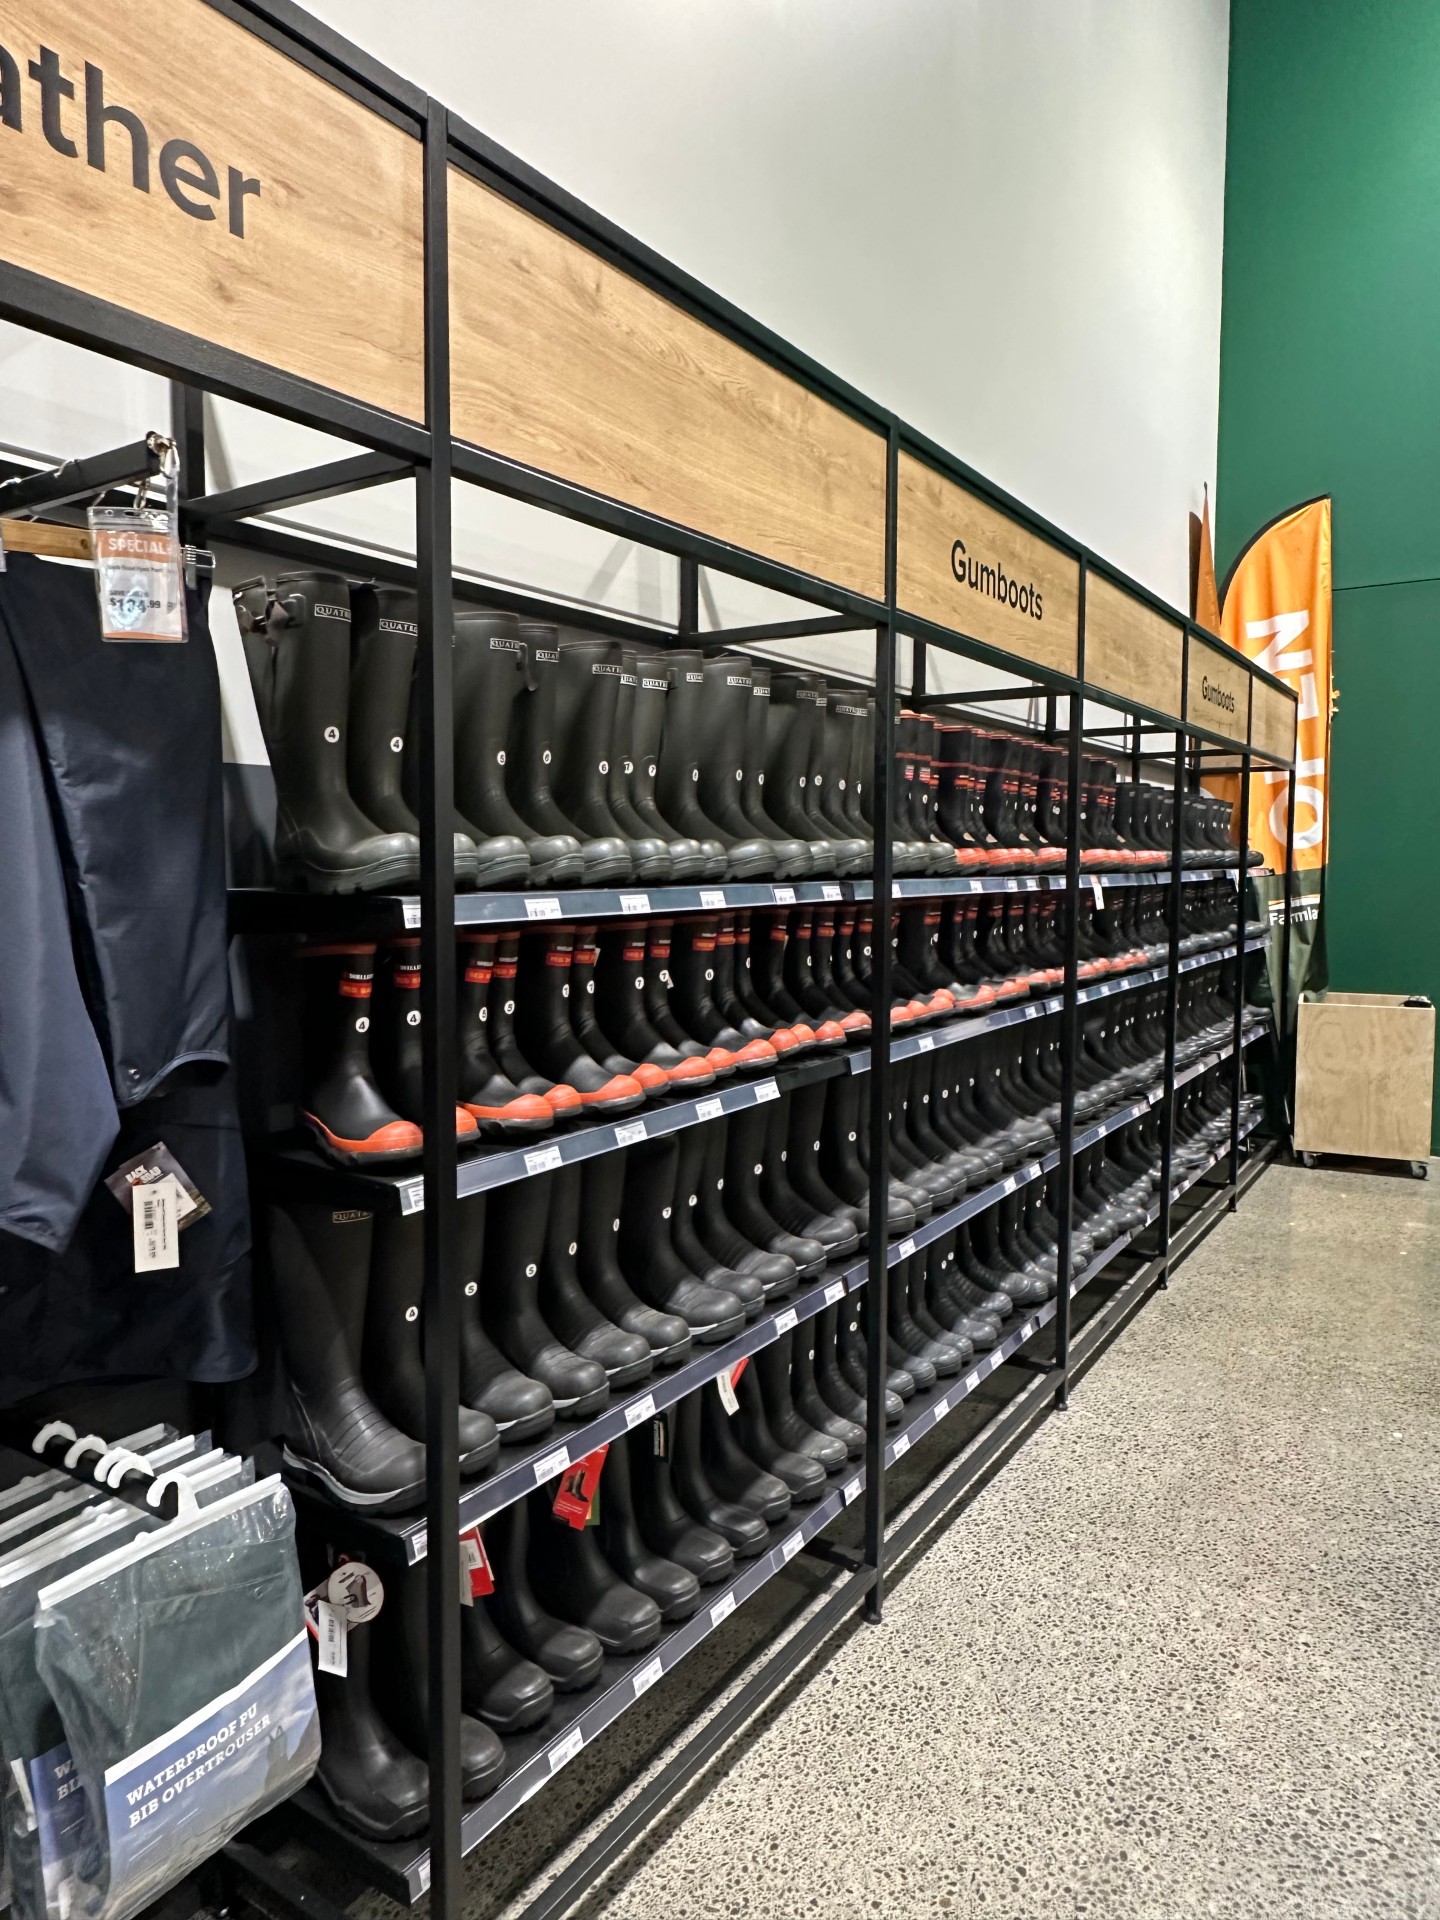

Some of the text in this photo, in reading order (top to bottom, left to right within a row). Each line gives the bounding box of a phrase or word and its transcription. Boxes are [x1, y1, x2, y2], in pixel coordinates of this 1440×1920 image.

[951, 539, 1043, 621] Gumboots
[1202, 676, 1235, 713] Gumboots
[126, 1703, 258, 1806] WATERPROOF PU
[129, 1798, 159, 1829] BIB
[162, 1714, 271, 1803] OVERTROUSER
